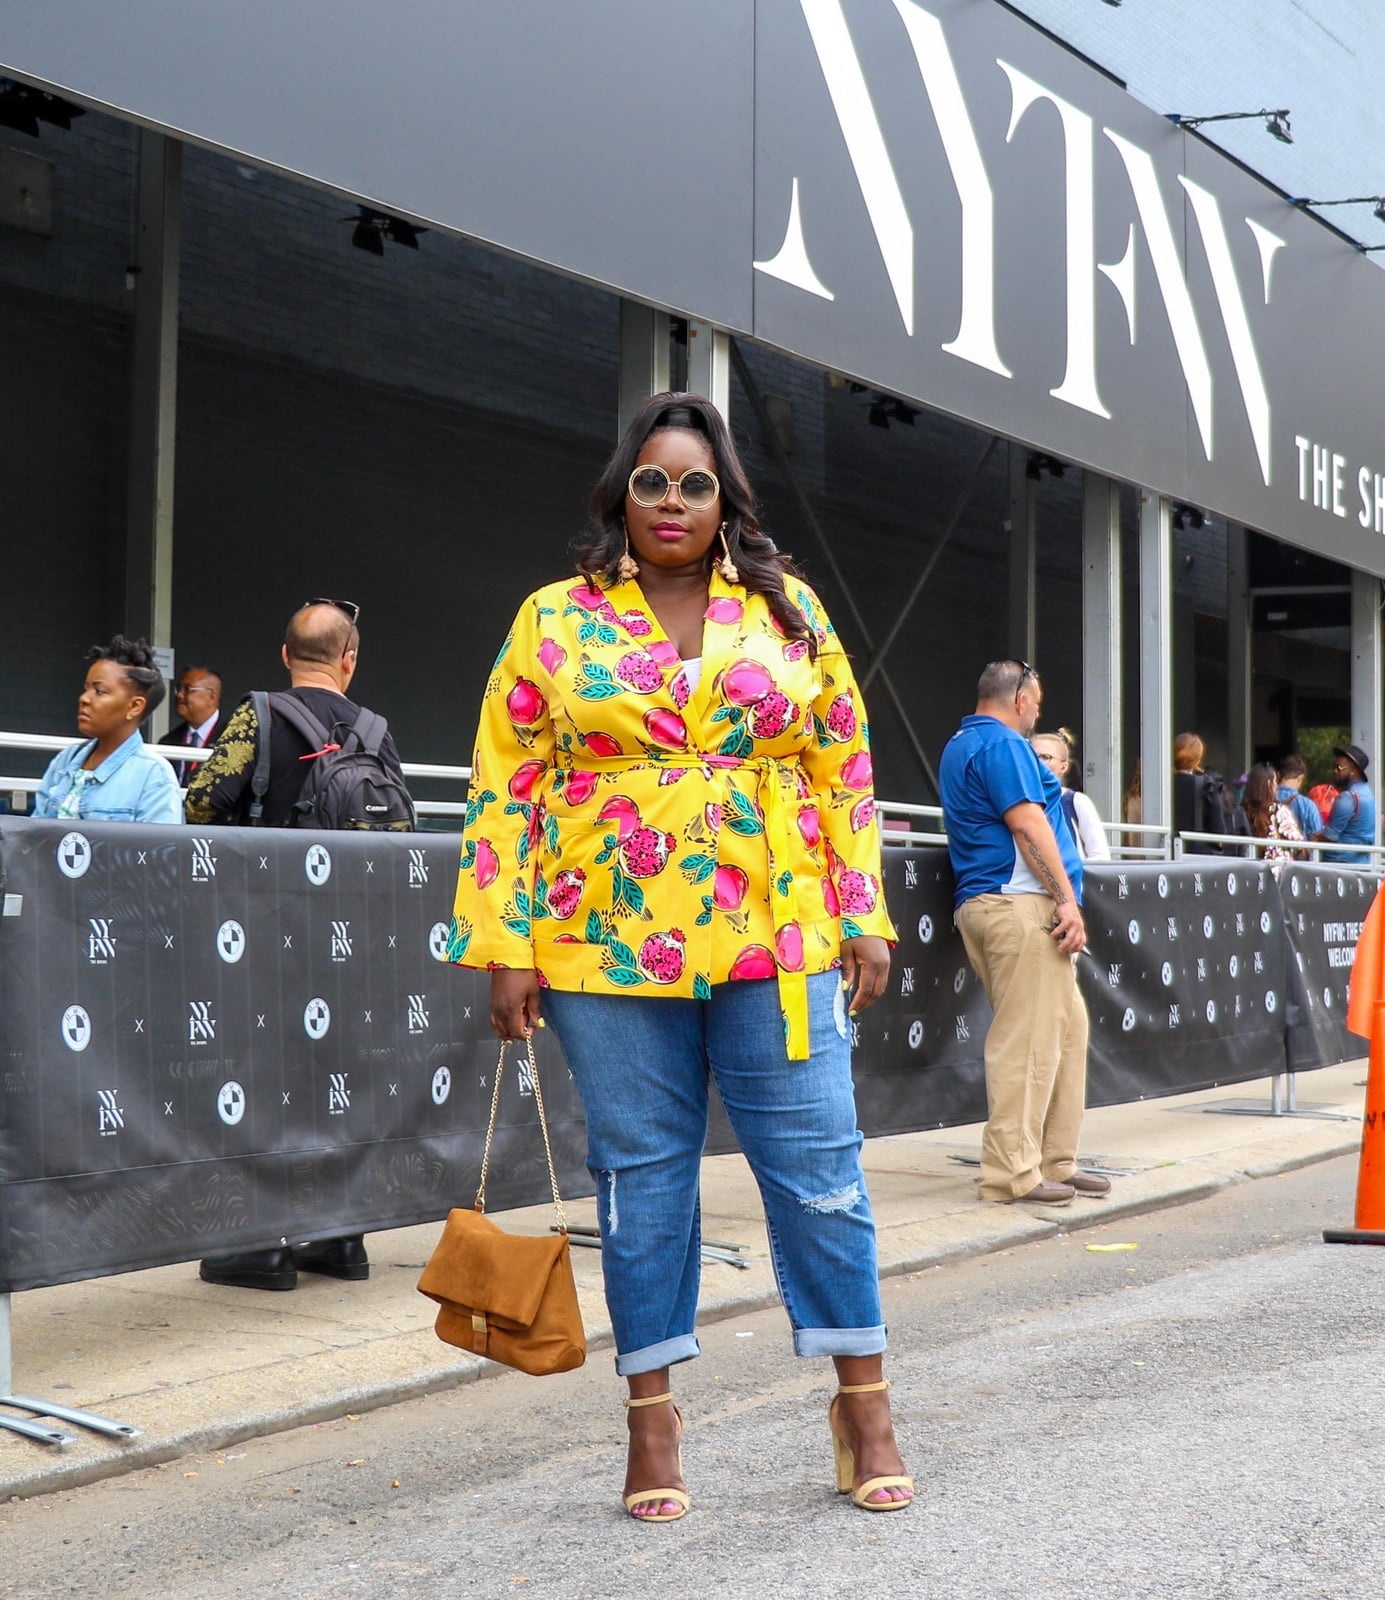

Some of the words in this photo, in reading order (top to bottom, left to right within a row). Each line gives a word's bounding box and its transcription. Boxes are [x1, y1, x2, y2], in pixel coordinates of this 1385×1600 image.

[1295, 434, 1345, 518] THE
[191, 838, 213, 857] NY
[192, 856, 218, 876] FW
[88, 919, 113, 938] NY
[1346, 922, 1359, 941] THE
[89, 938, 117, 958] FW
[189, 1002, 212, 1020] NY
[190, 1020, 216, 1040] FW
[97, 1090, 118, 1109] NY
[99, 1109, 124, 1130] FW
